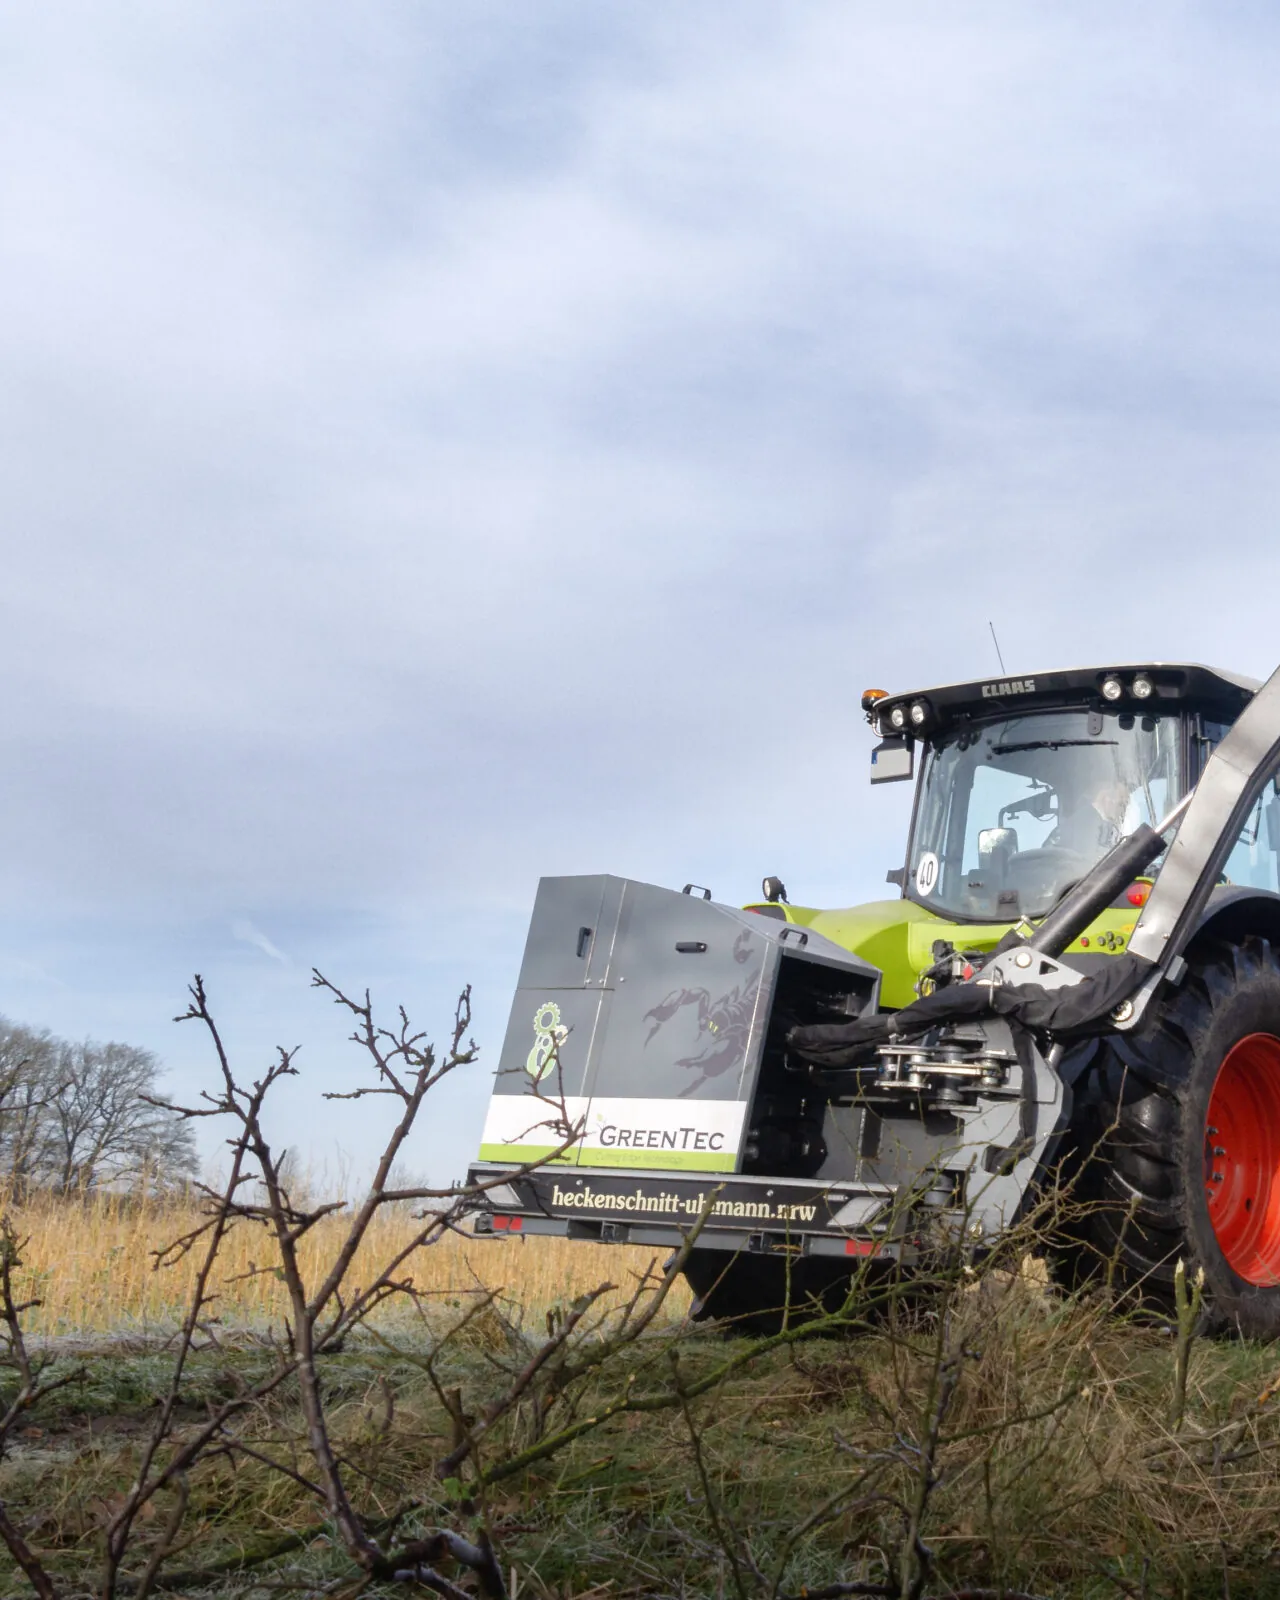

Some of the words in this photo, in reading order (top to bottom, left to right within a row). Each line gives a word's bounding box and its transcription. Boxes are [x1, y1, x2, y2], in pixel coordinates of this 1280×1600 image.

[981, 679, 1036, 698] CLAAS
[919, 860, 934, 889] 40
[551, 1184, 817, 1221] heckenschnitt-uhmann.nrw
